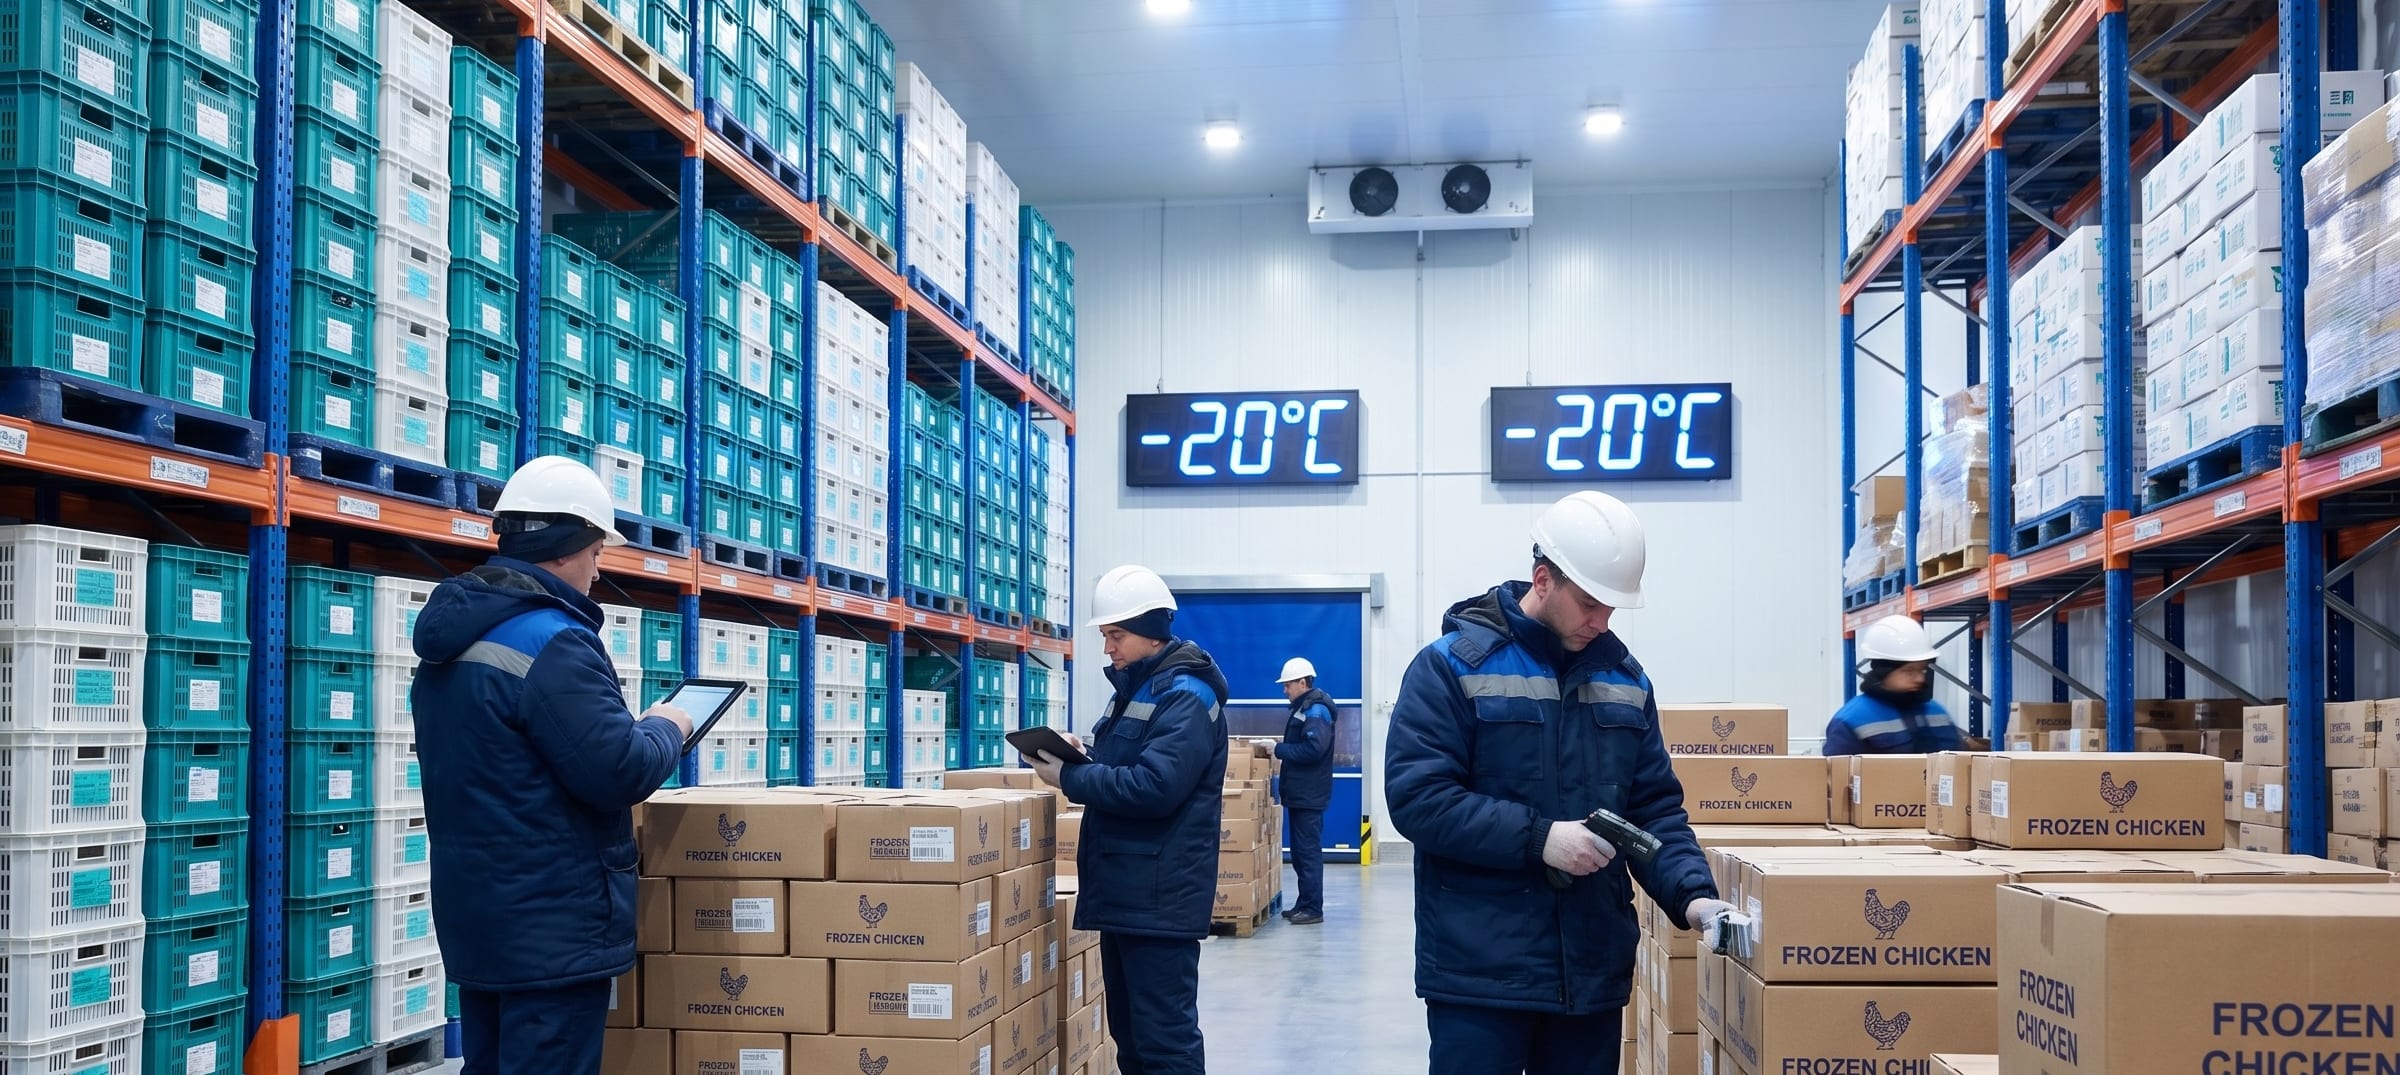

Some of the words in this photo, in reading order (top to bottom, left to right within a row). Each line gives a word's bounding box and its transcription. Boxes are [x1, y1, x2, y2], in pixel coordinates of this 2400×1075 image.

[1699, 800, 1742, 810] FROZEN
[1744, 800, 1792, 810] CHICKEN
[2028, 818, 2109, 836] FROZEN
[2115, 818, 2205, 836] CHICKEN
[685, 850, 729, 862] FROZEN
[826, 932, 871, 944] FROZEN
[873, 933, 925, 946] CHICKEN
[1782, 946, 1877, 966] FROZEN
[1884, 946, 1991, 966] CHICKEN
[2019, 968, 2075, 1019] FROZEN
[687, 1003, 732, 1015] FROZEN
[734, 1004, 785, 1017] CHICKEN
[2213, 1002, 2394, 1038] FROZEN
[2016, 1009, 2078, 1067] CHICKEN
[1782, 1058, 1877, 1075] FROZEN
[1884, 1058, 1929, 1075] CHI
[2202, 1050, 2400, 1075] CHICKEN
